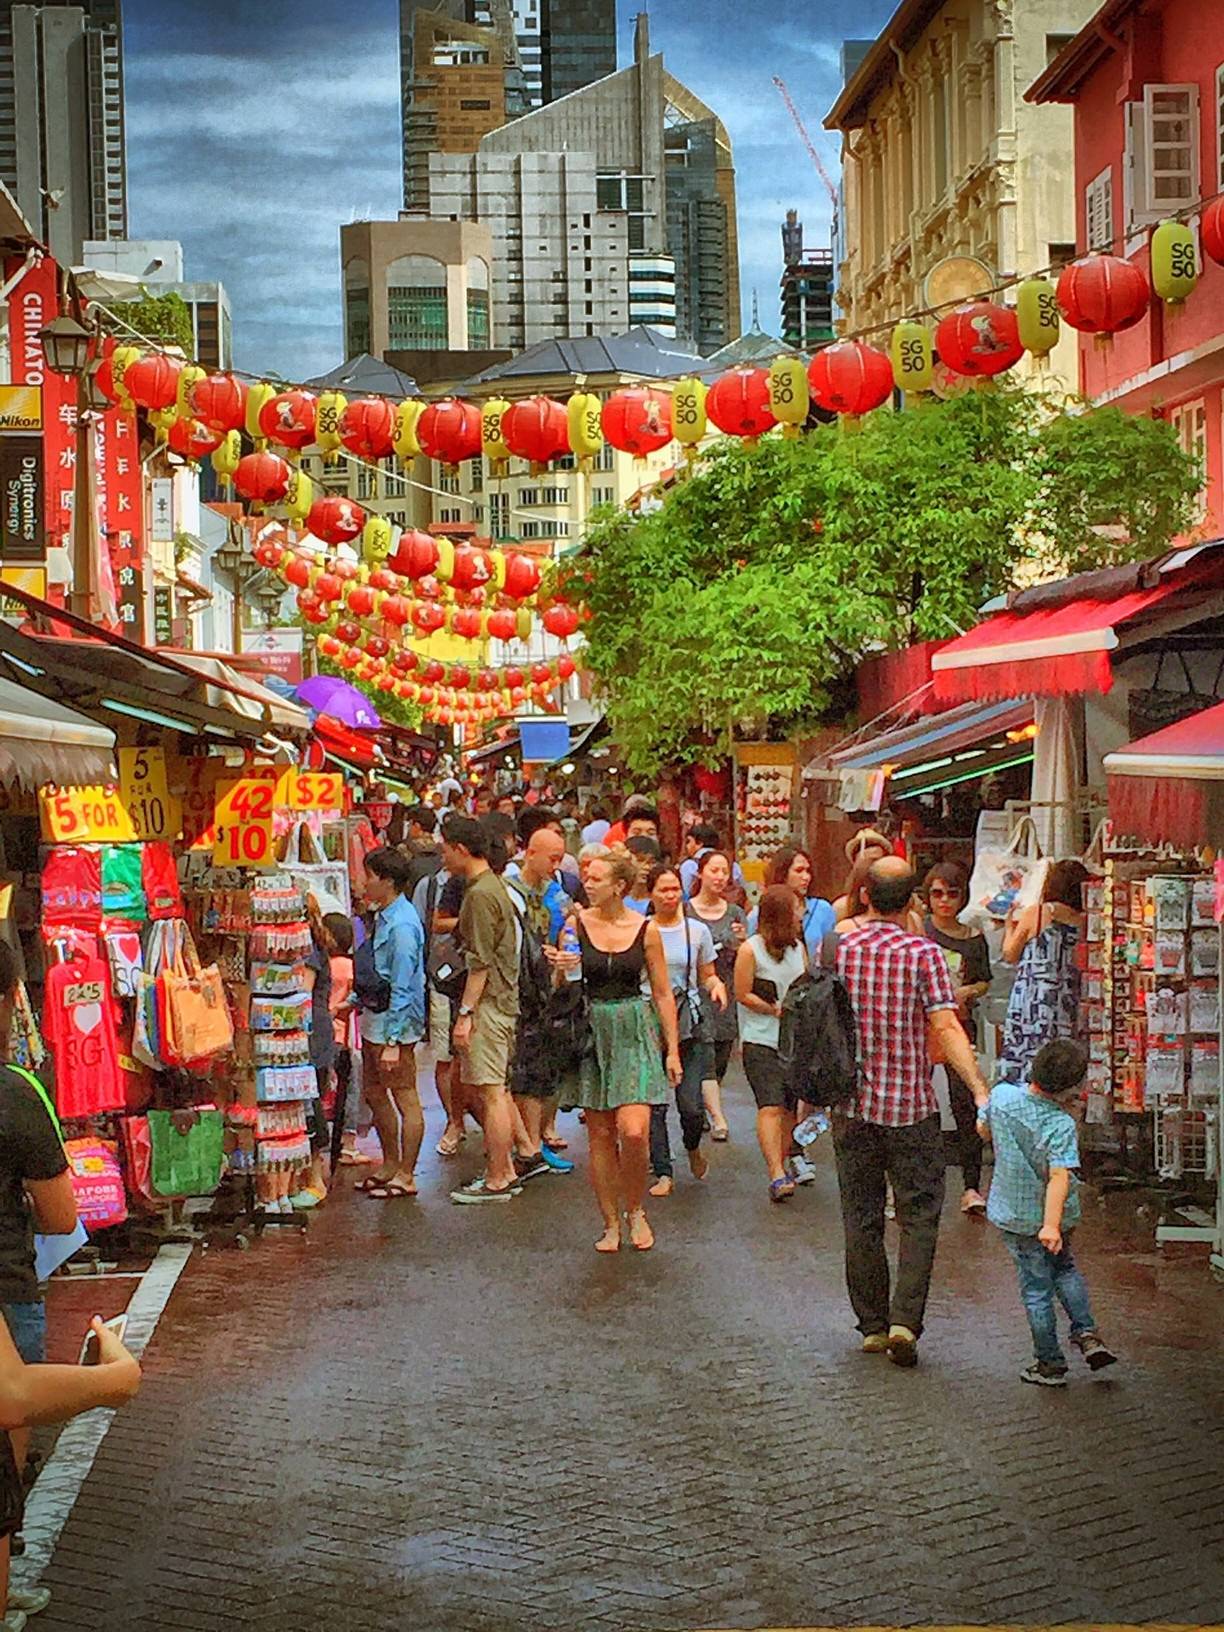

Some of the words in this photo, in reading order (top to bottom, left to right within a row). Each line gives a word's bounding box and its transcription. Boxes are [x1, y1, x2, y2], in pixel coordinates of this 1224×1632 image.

[1171, 242, 1194, 260] SG
[1171, 260, 1195, 279] 50
[1039, 311, 1059, 329] 50
[900, 339, 923, 355] SG
[901, 356, 925, 373] 50
[772, 372, 792, 389] SG
[676, 394, 697, 408] SG
[772, 388, 793, 405] 50
[0, 415, 40, 427] Nikon
[319, 408, 337, 419] SG
[483, 414, 499, 428] SG
[676, 409, 697, 424] 50
[319, 421, 338, 433] 50
[483, 428, 500, 442] 50
[20, 457, 38, 541] Digitronics
[7, 480, 22, 536] Synergy
[133, 750, 149, 780] 5
[296, 775, 336, 806] $2
[230, 784, 274, 820] 42
[54, 797, 77, 833] 5
[82, 802, 119, 828] FOR
[129, 797, 165, 835] $10
